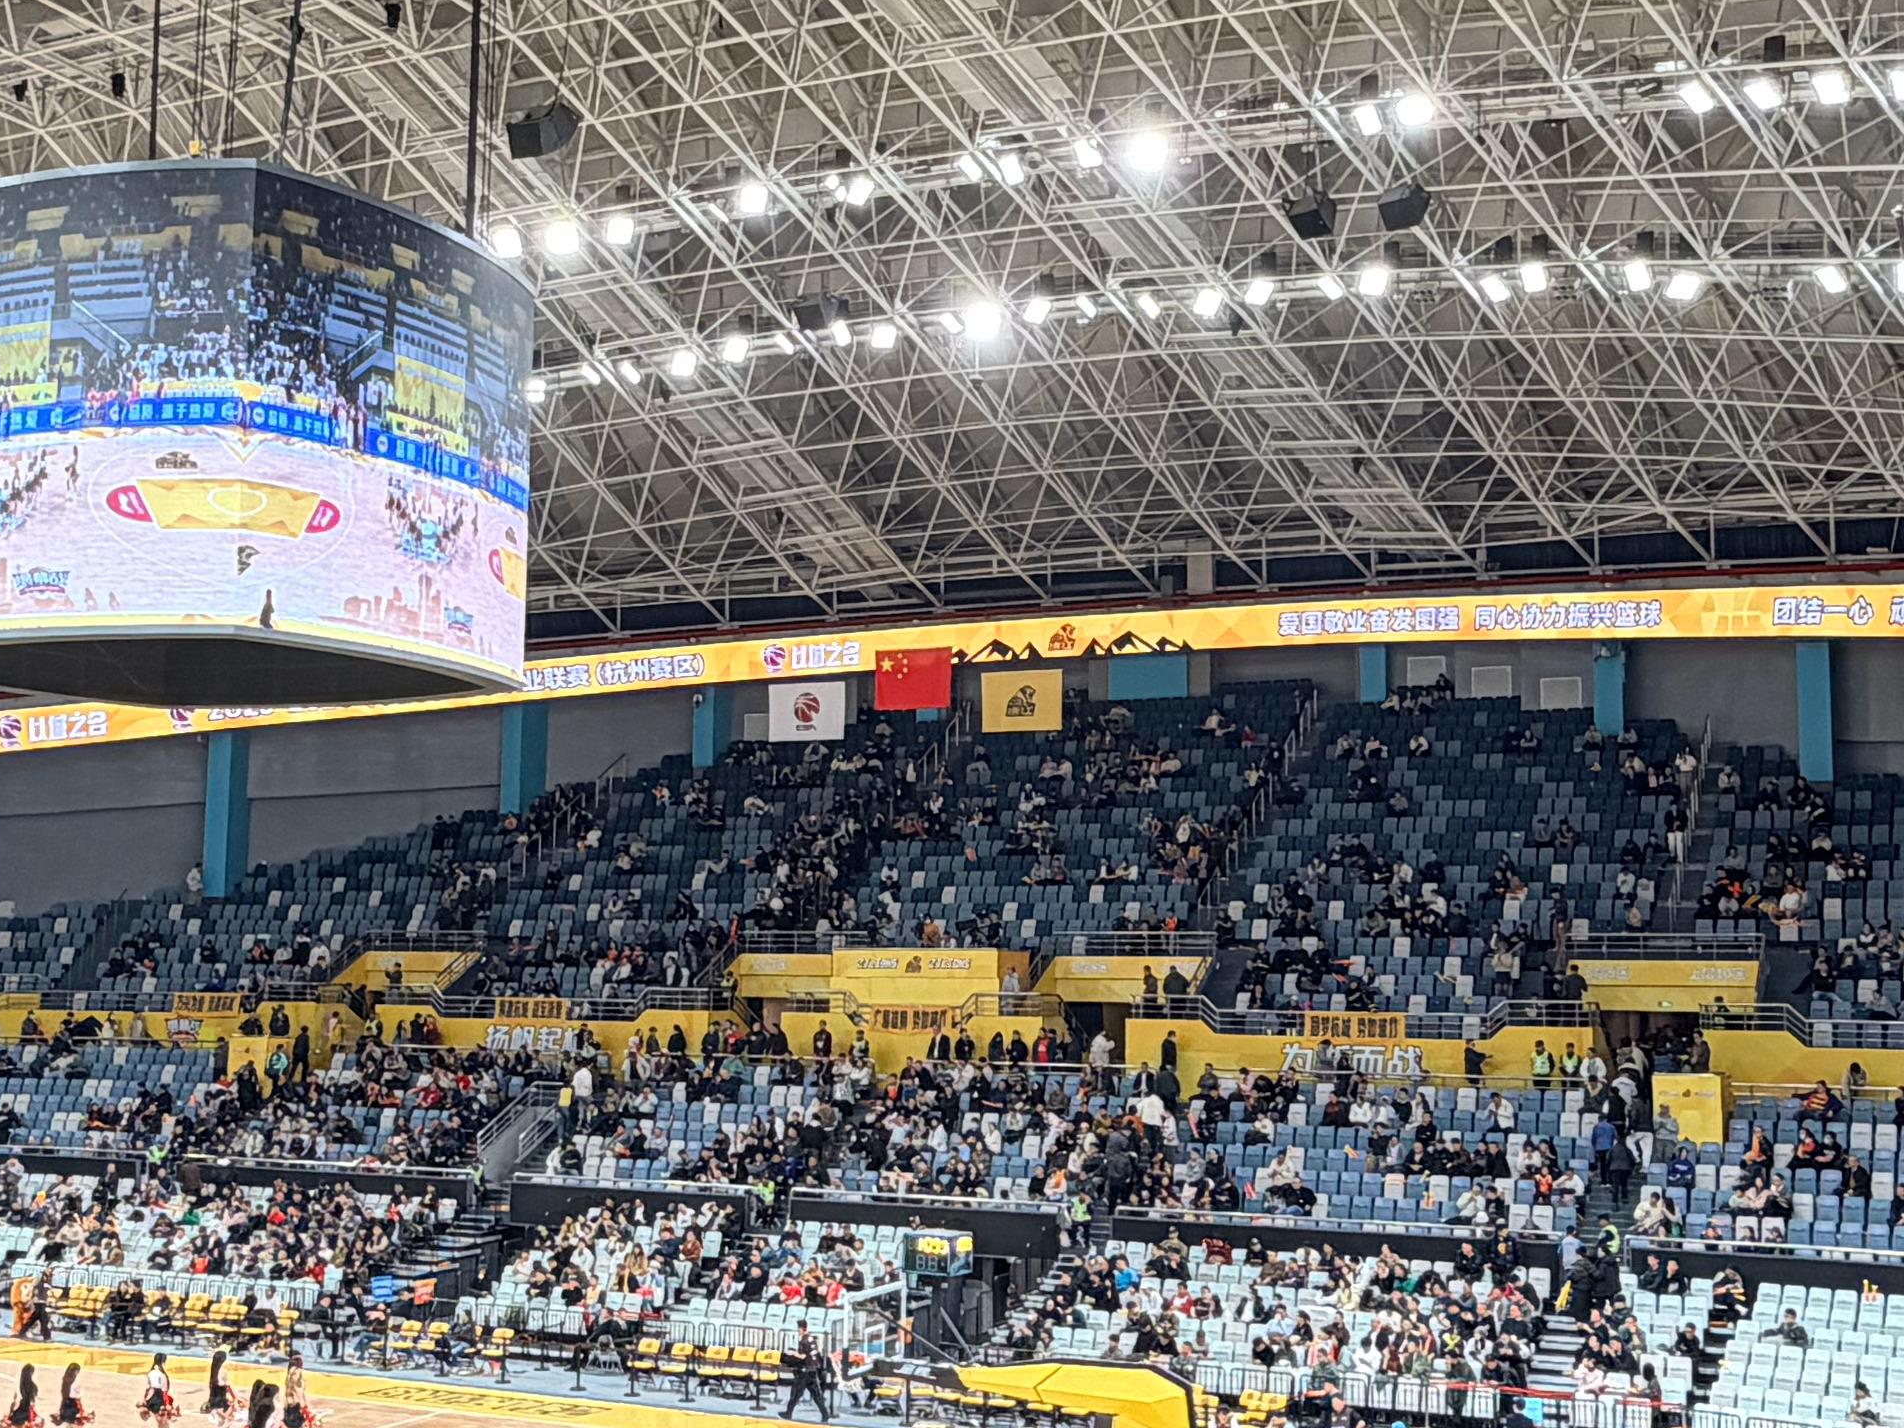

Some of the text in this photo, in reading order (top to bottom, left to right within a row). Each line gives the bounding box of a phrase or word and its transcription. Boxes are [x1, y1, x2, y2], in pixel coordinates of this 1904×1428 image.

[1277, 600, 1662, 636] 爱国敬业奋发图强 同心协力振兴篮球
[1771, 595, 1874, 627] 团结一心
